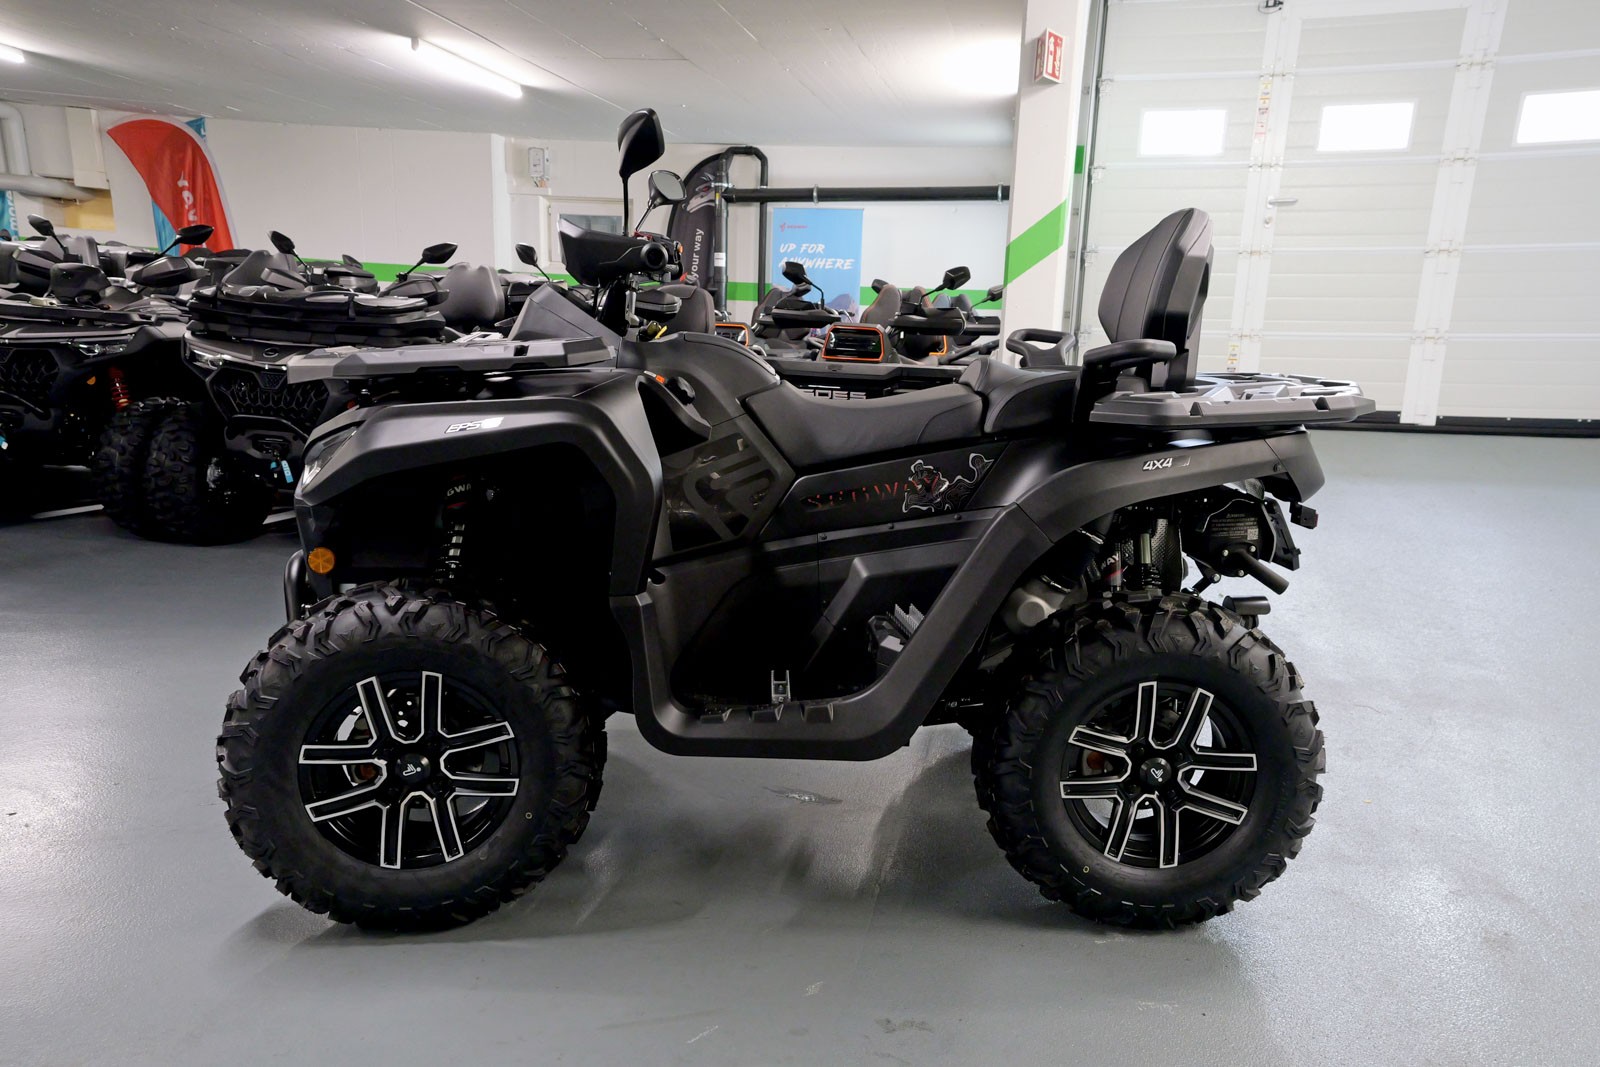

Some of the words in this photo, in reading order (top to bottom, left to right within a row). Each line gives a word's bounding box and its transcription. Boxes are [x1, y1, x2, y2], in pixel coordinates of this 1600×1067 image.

[694, 228, 704, 251] way
[779, 243, 796, 253] UP
[800, 243, 825, 254] FOR
[691, 252, 699, 279] your
[445, 421, 481, 433] EPS
